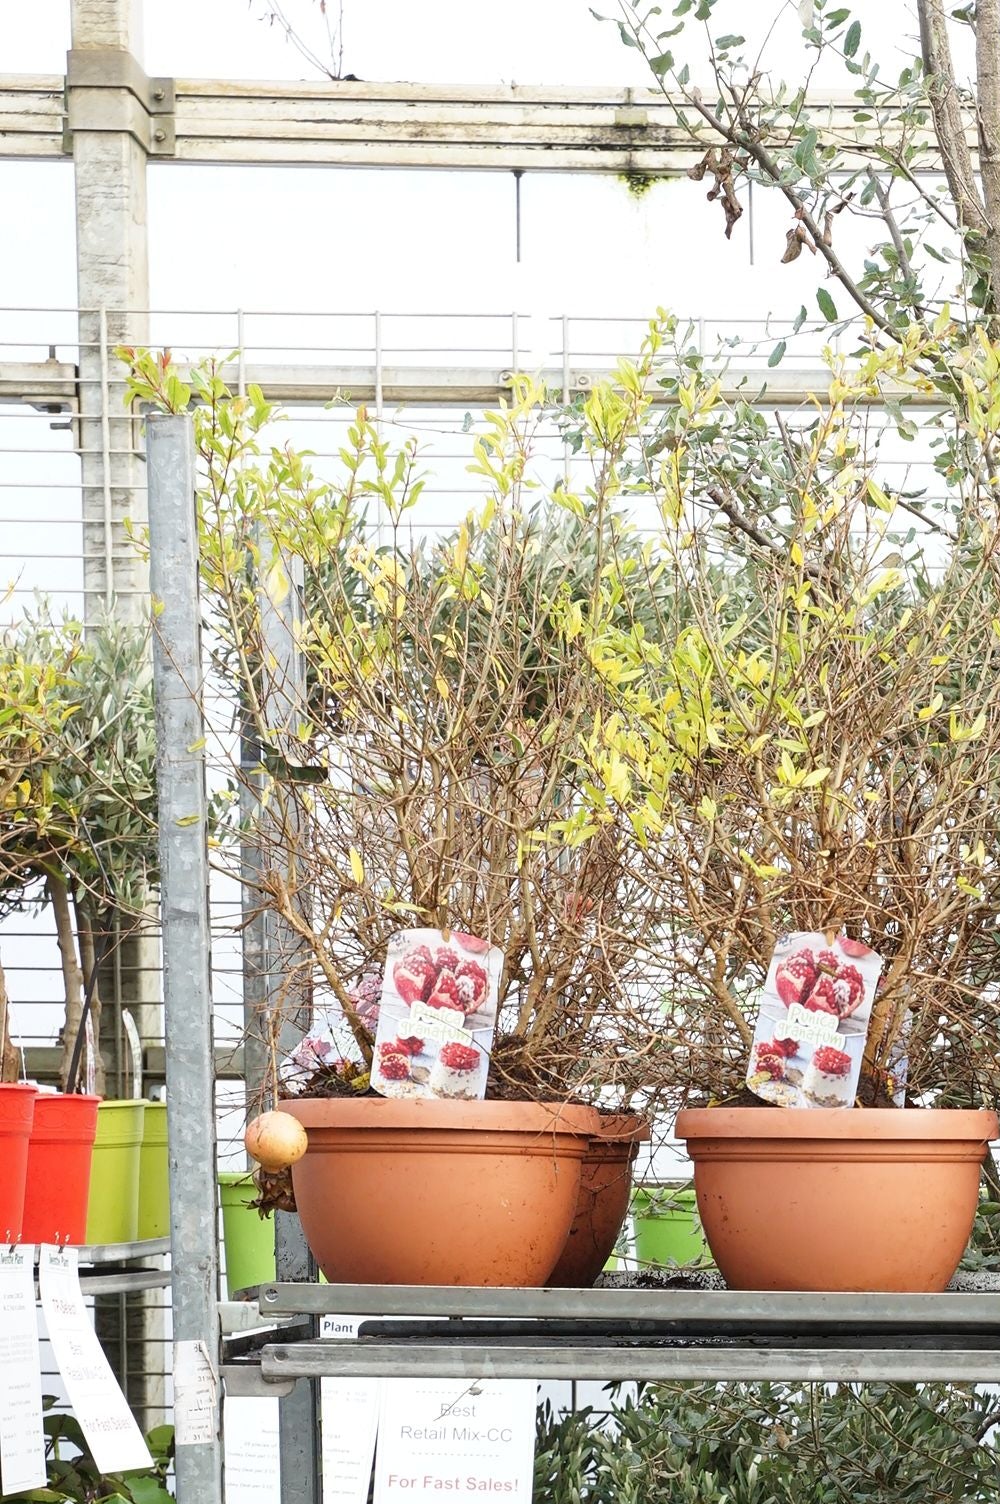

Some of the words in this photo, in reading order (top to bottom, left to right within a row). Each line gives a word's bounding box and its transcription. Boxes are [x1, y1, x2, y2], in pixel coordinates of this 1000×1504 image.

[323, 1321, 354, 1333] Plant
[440, 1403, 477, 1418] Best
[400, 1425, 447, 1440] Retail
[452, 1427, 513, 1442] Mix-CC
[388, 1474, 417, 1489] For
[423, 1475, 460, 1490] Fast
[466, 1476, 519, 1492] Sales!
